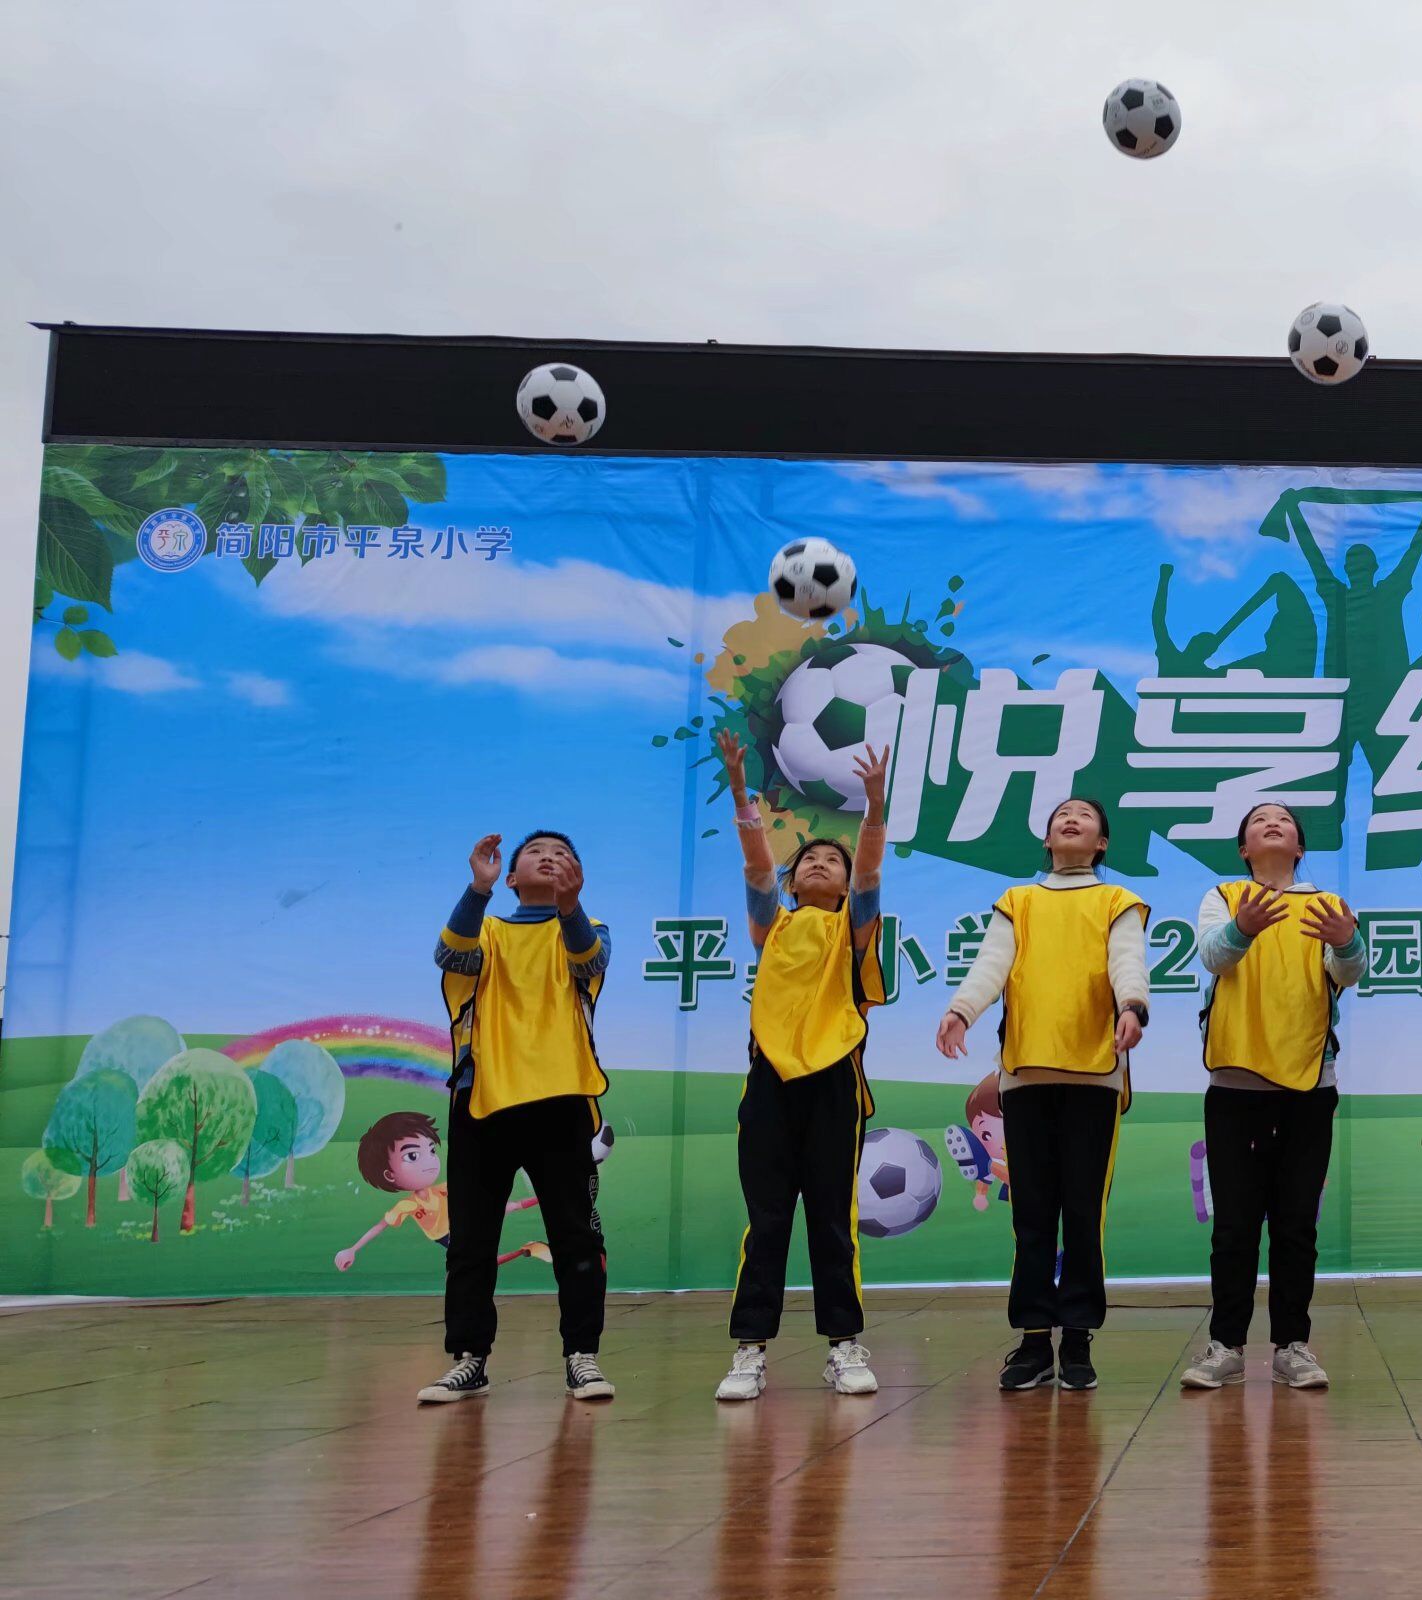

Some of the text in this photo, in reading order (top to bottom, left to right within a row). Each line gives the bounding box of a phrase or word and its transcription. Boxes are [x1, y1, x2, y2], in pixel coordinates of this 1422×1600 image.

[216, 523, 513, 561] 简阳市平泉小学
